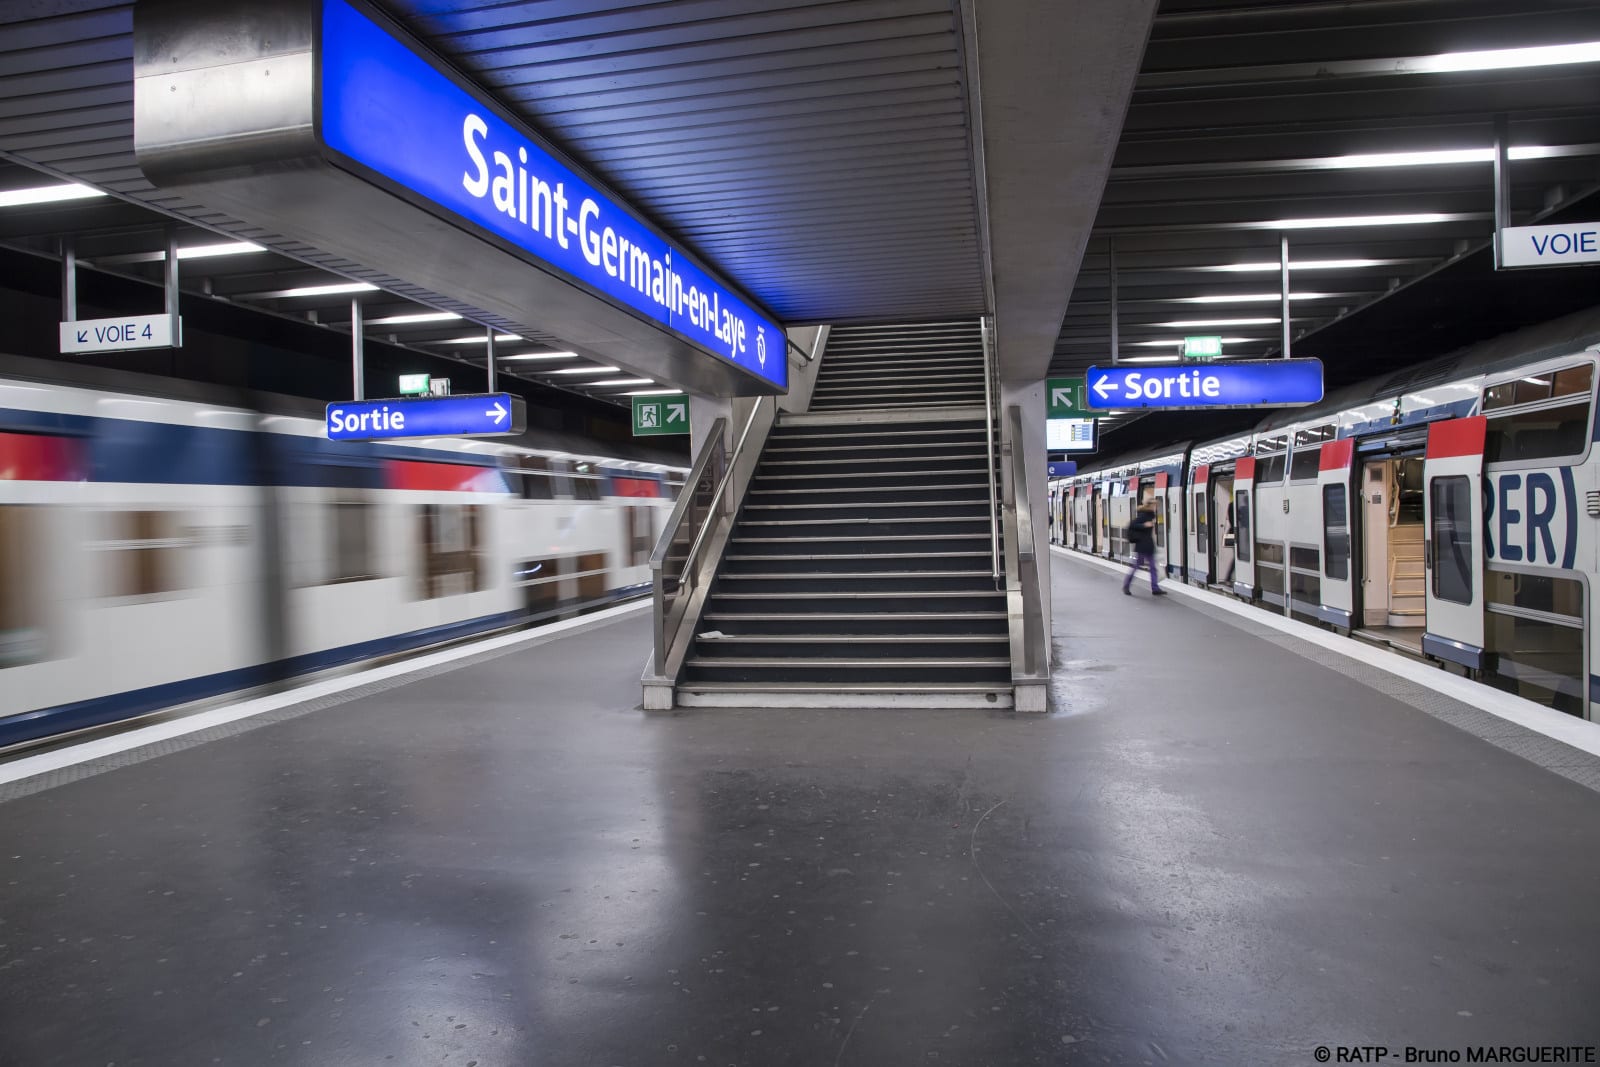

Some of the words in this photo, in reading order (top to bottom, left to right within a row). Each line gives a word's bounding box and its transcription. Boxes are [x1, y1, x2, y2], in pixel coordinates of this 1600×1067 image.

[463, 113, 746, 358] Saint-Germain-en-Laye
[1531, 231, 1598, 256] VOIE
[95, 324, 136, 344] VOIE
[141, 323, 153, 340] 4
[1124, 370, 1220, 399] Sortie
[330, 406, 405, 433] Sortie
